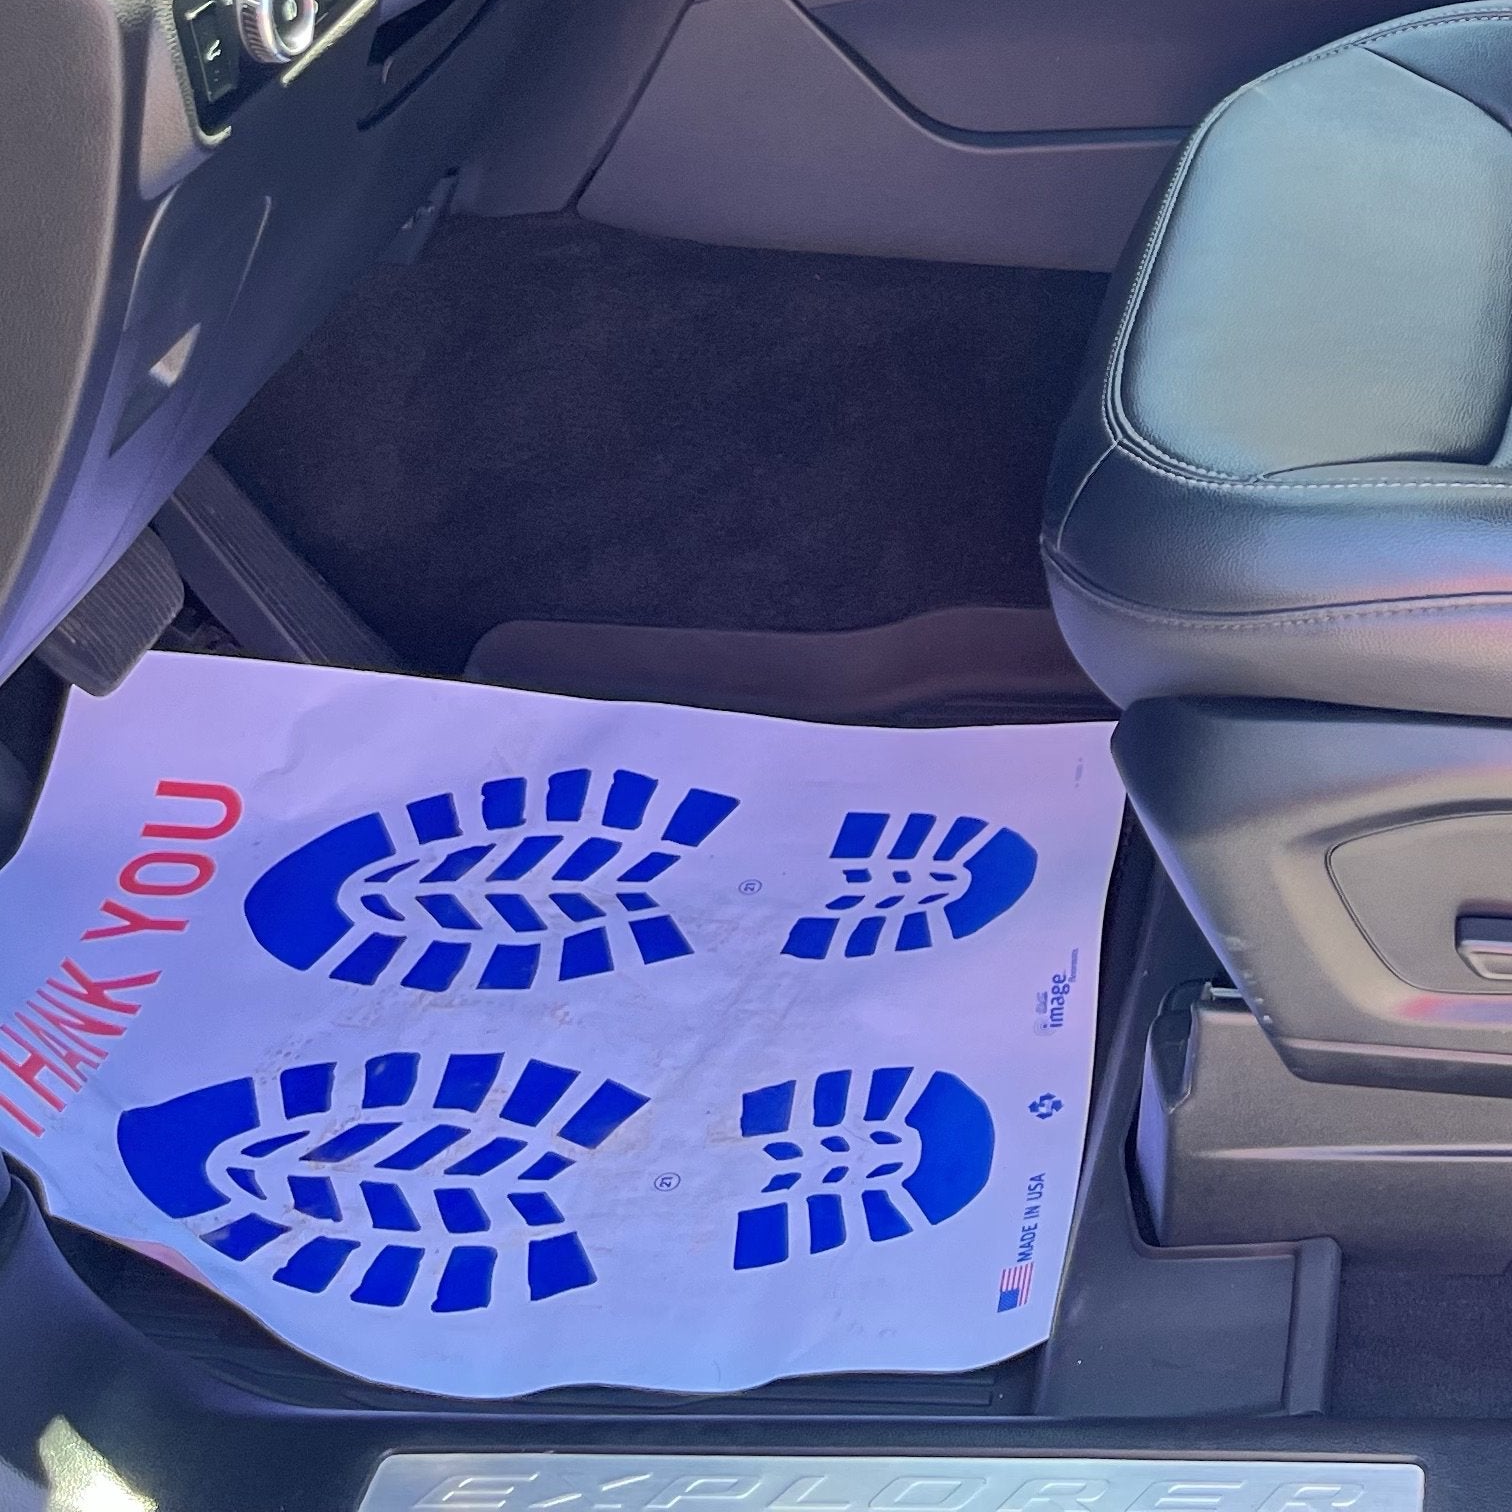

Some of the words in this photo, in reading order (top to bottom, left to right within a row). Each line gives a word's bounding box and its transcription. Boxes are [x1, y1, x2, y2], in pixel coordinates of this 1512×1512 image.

[81, 779, 244, 941] YOU
[1041, 973, 1070, 1029] image
[1028, 1172, 1047, 1200] USA
[1023, 1204, 1041, 1219] IN
[1016, 1222, 1038, 1262] MADE
[410, 1472, 1369, 1512] EXPLORER
